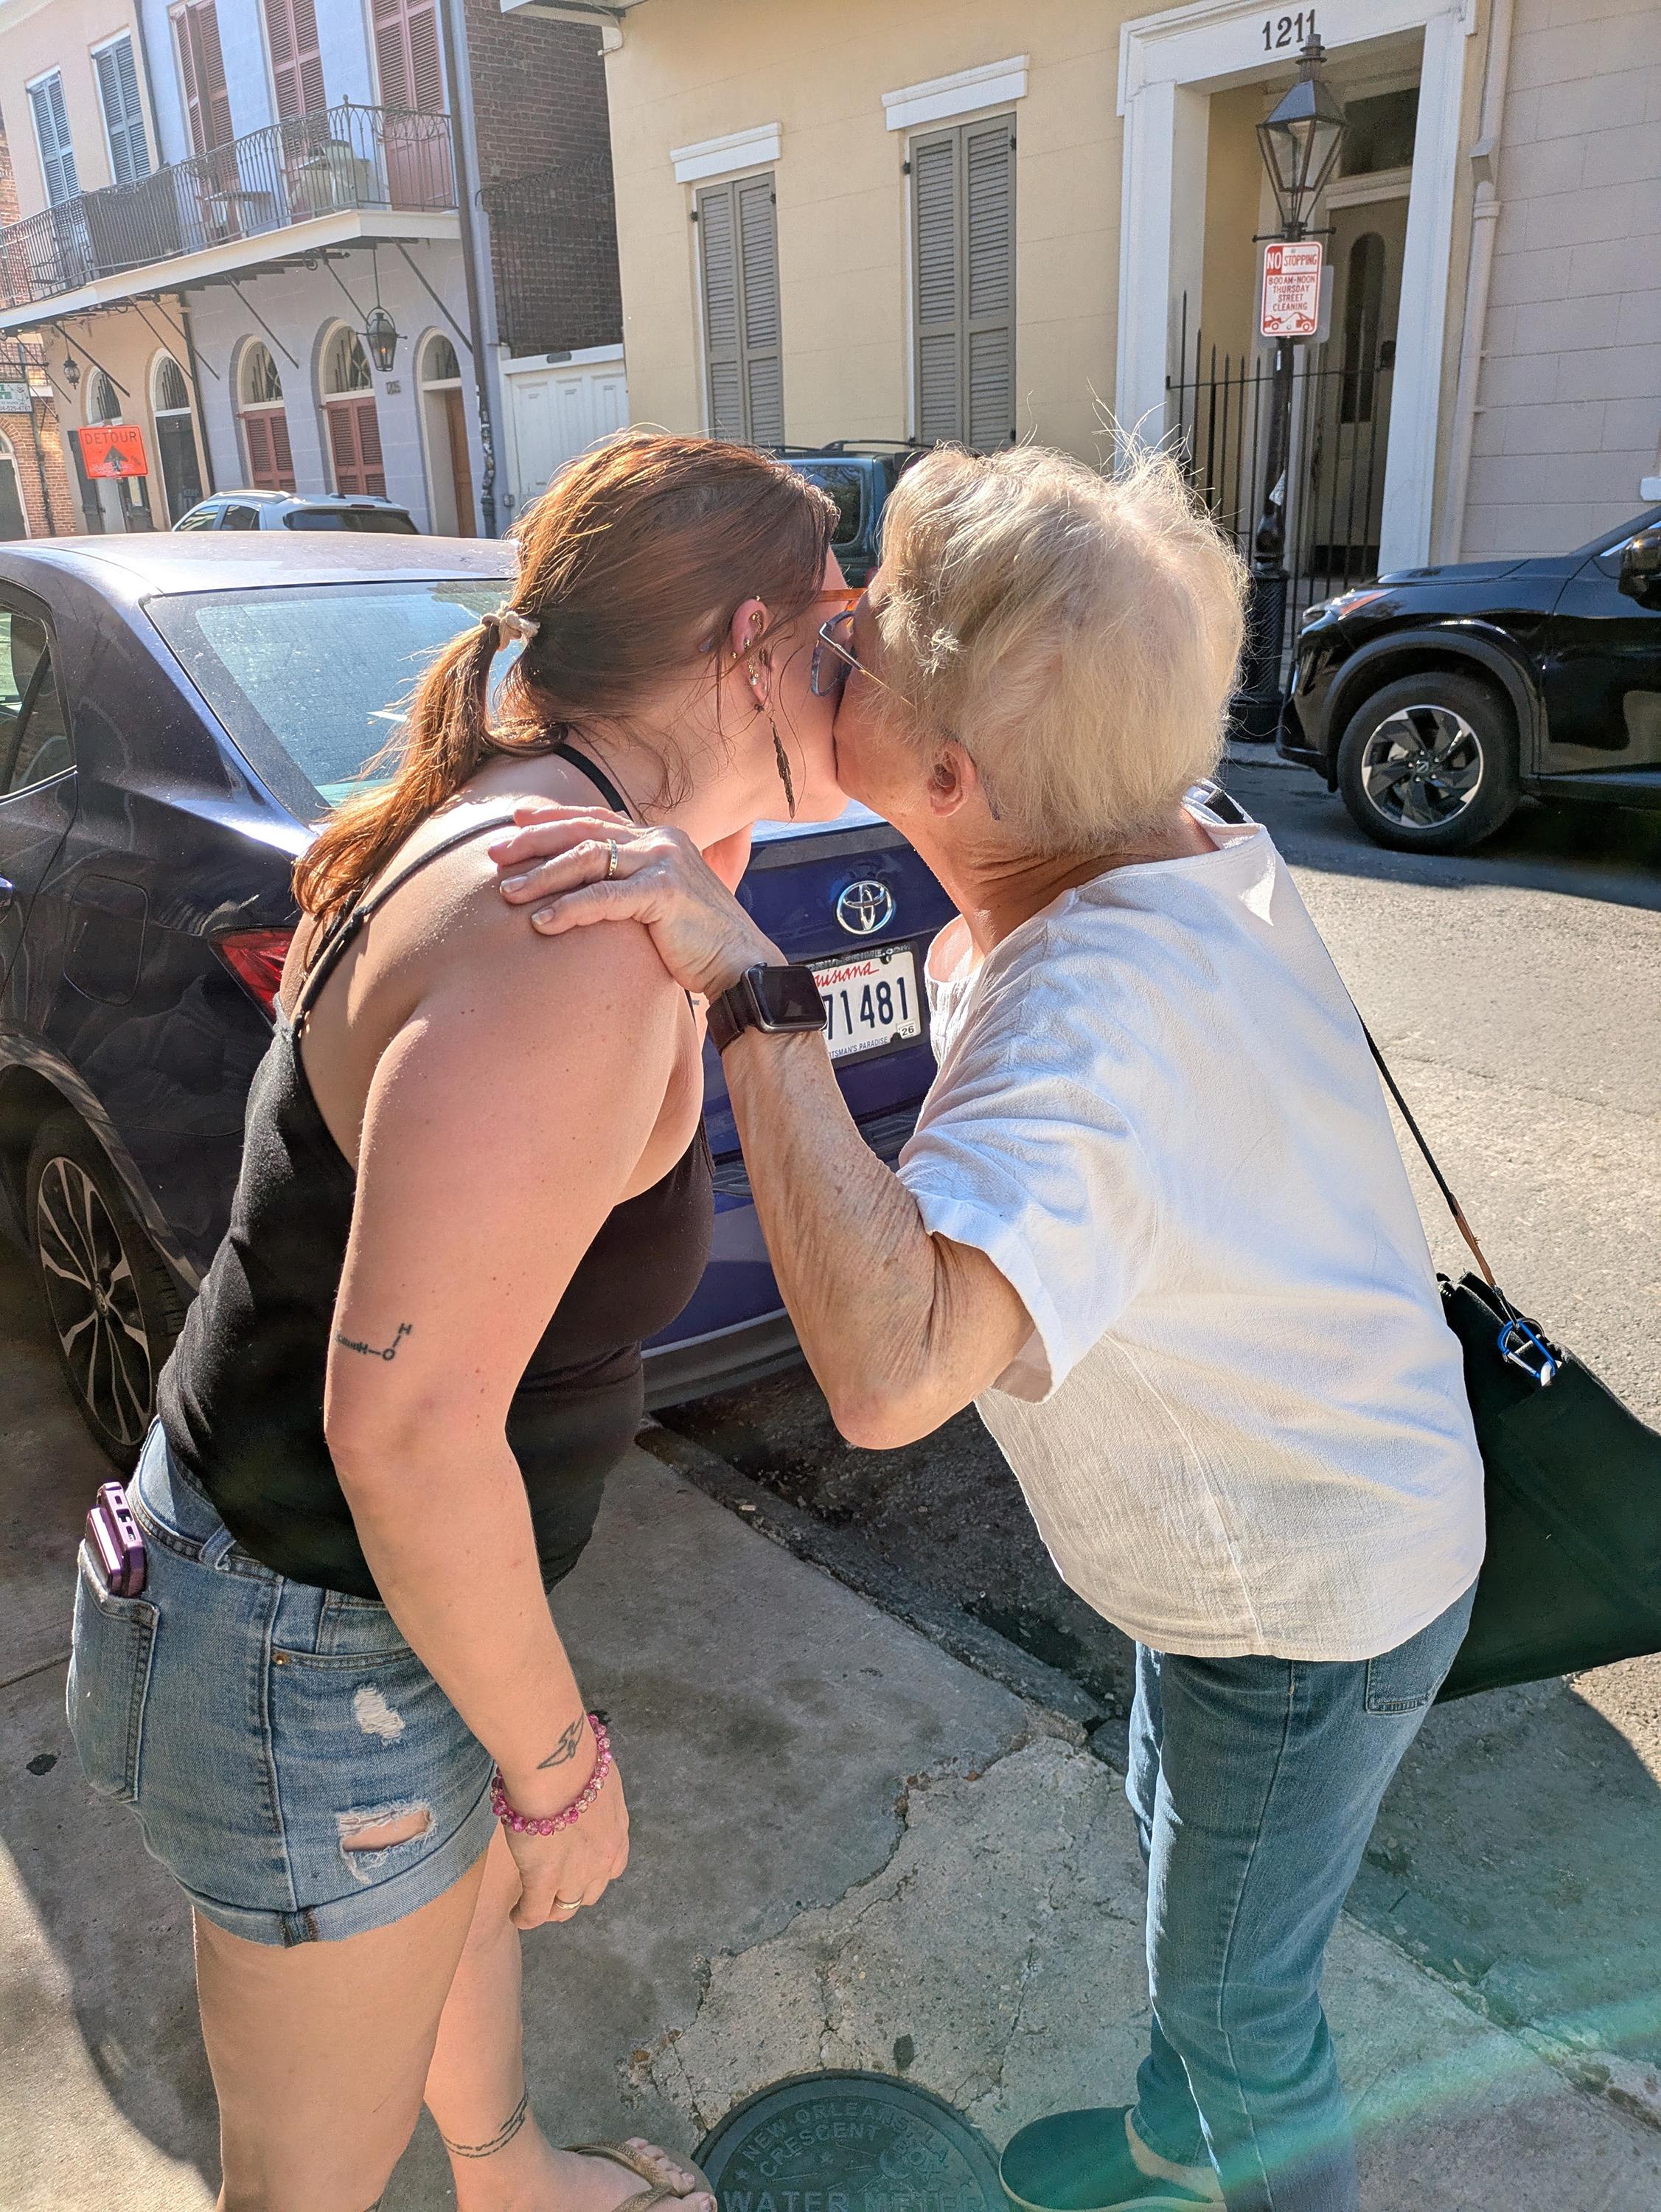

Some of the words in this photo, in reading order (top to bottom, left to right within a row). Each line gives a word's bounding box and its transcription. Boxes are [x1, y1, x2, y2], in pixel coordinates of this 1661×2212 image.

[1262, 9, 1315, 51] 1211
[1267, 252, 1281, 270] NO
[1284, 254, 1317, 267] STOPPING
[1272, 285, 1310, 294] THURSDAY
[1278, 293, 1303, 302] STREET
[1272, 302, 1308, 312] CLEANING
[84, 431, 138, 445] DETOUR
[901, 1026, 914, 1037] 26
[859, 1036, 888, 1049] PARADISE
[742, 2118, 787, 2162] NEW
[759, 2122, 880, 2177] CRESCENT
[722, 2190, 849, 2212] WATER
[864, 2188, 981, 2212] METER
